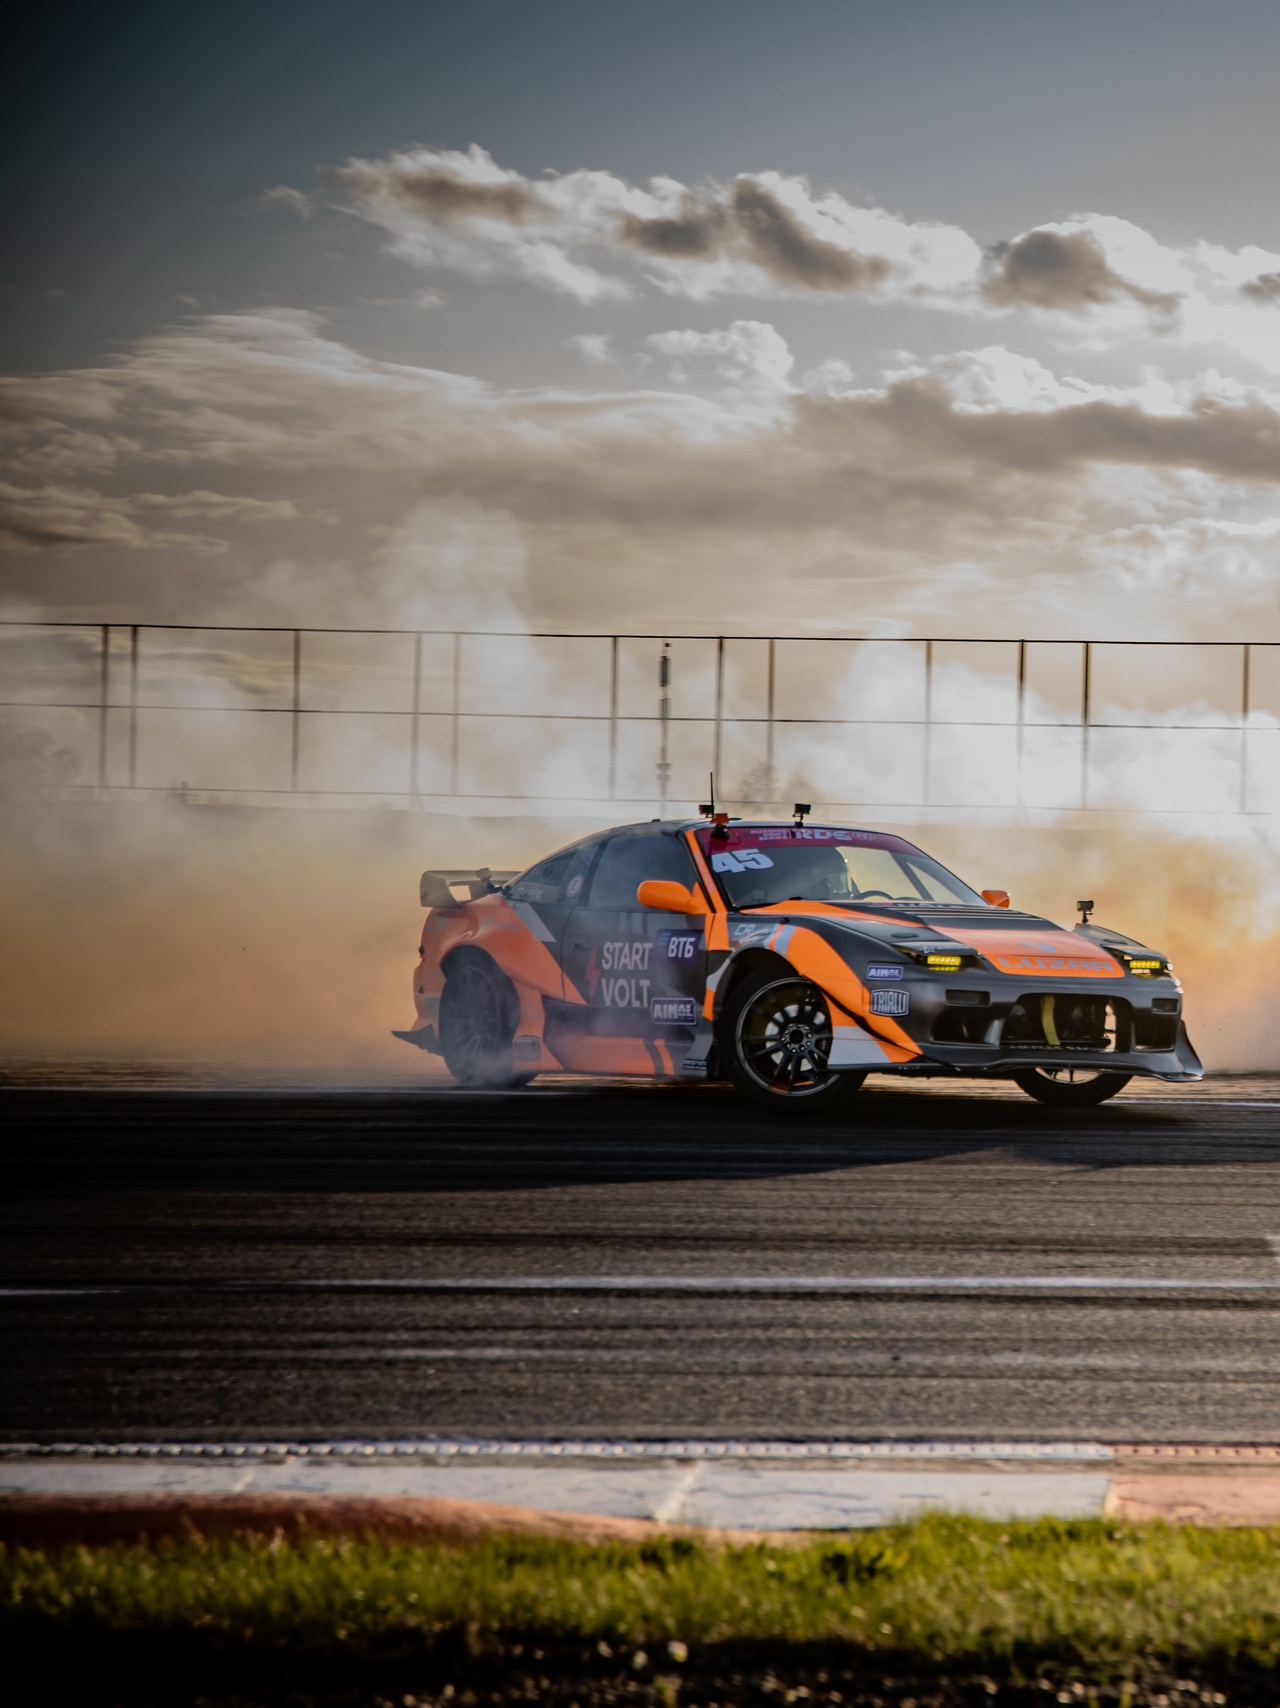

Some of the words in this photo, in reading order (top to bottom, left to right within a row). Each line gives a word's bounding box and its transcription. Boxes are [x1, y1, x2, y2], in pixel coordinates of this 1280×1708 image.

[791, 829, 853, 841] RDS
[711, 849, 774, 873] 45
[734, 924, 756, 935] CR
[602, 941, 653, 970] START
[668, 937, 696, 958] ВТБ
[998, 957, 1116, 972] LUZAR
[601, 978, 650, 1008] VOLT
[873, 991, 906, 1014] TRIALLI
[653, 1003, 694, 1019] AIMOL
